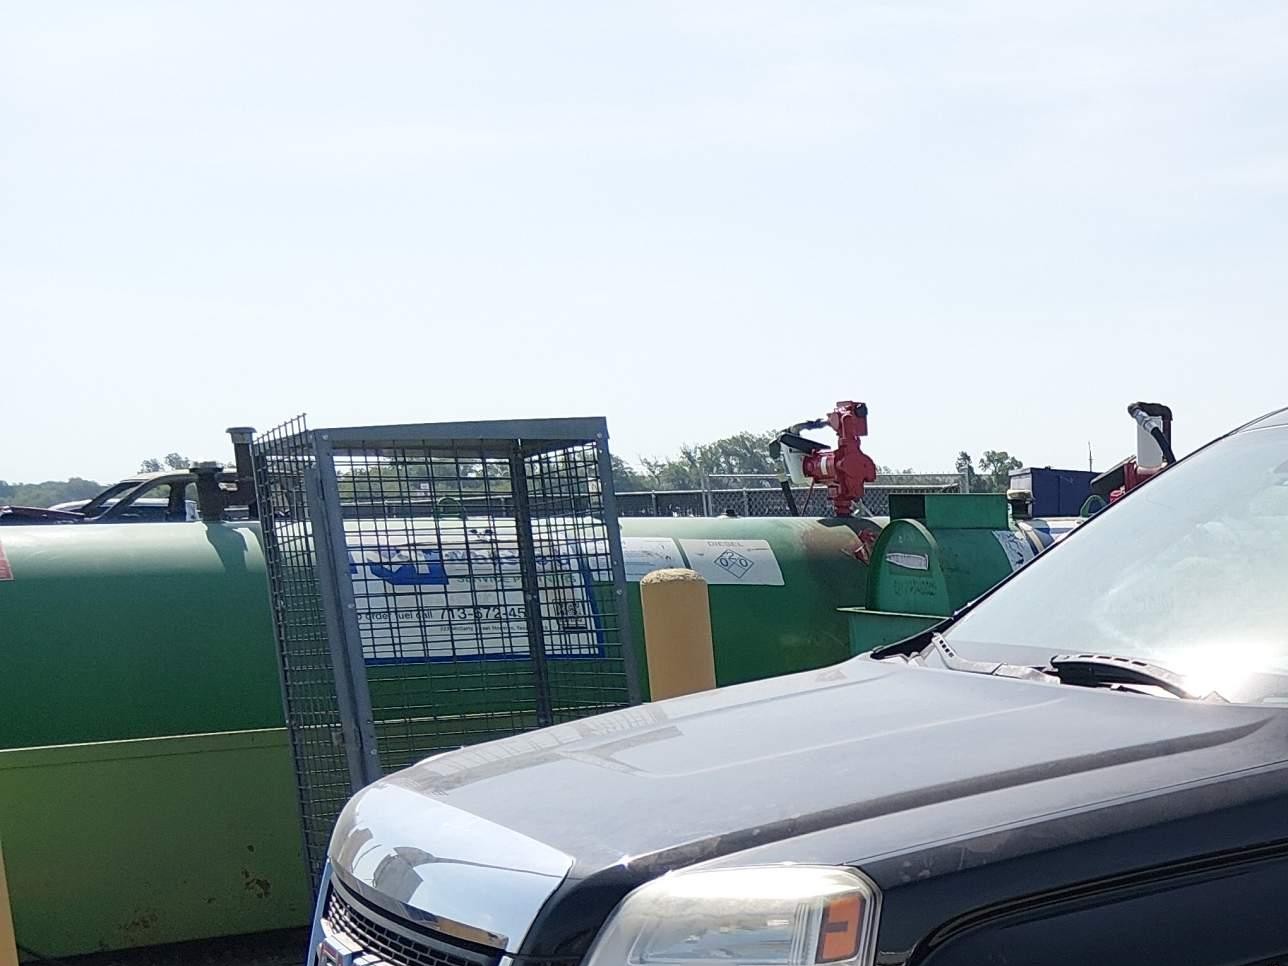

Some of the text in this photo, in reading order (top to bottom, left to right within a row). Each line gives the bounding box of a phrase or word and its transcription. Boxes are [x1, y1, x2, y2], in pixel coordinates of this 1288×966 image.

[707, 540, 745, 548] DIESEL
[726, 551, 738, 562] 2
[719, 557, 749, 569] 0 0
[440, 607, 527, 620] 713-672-45
